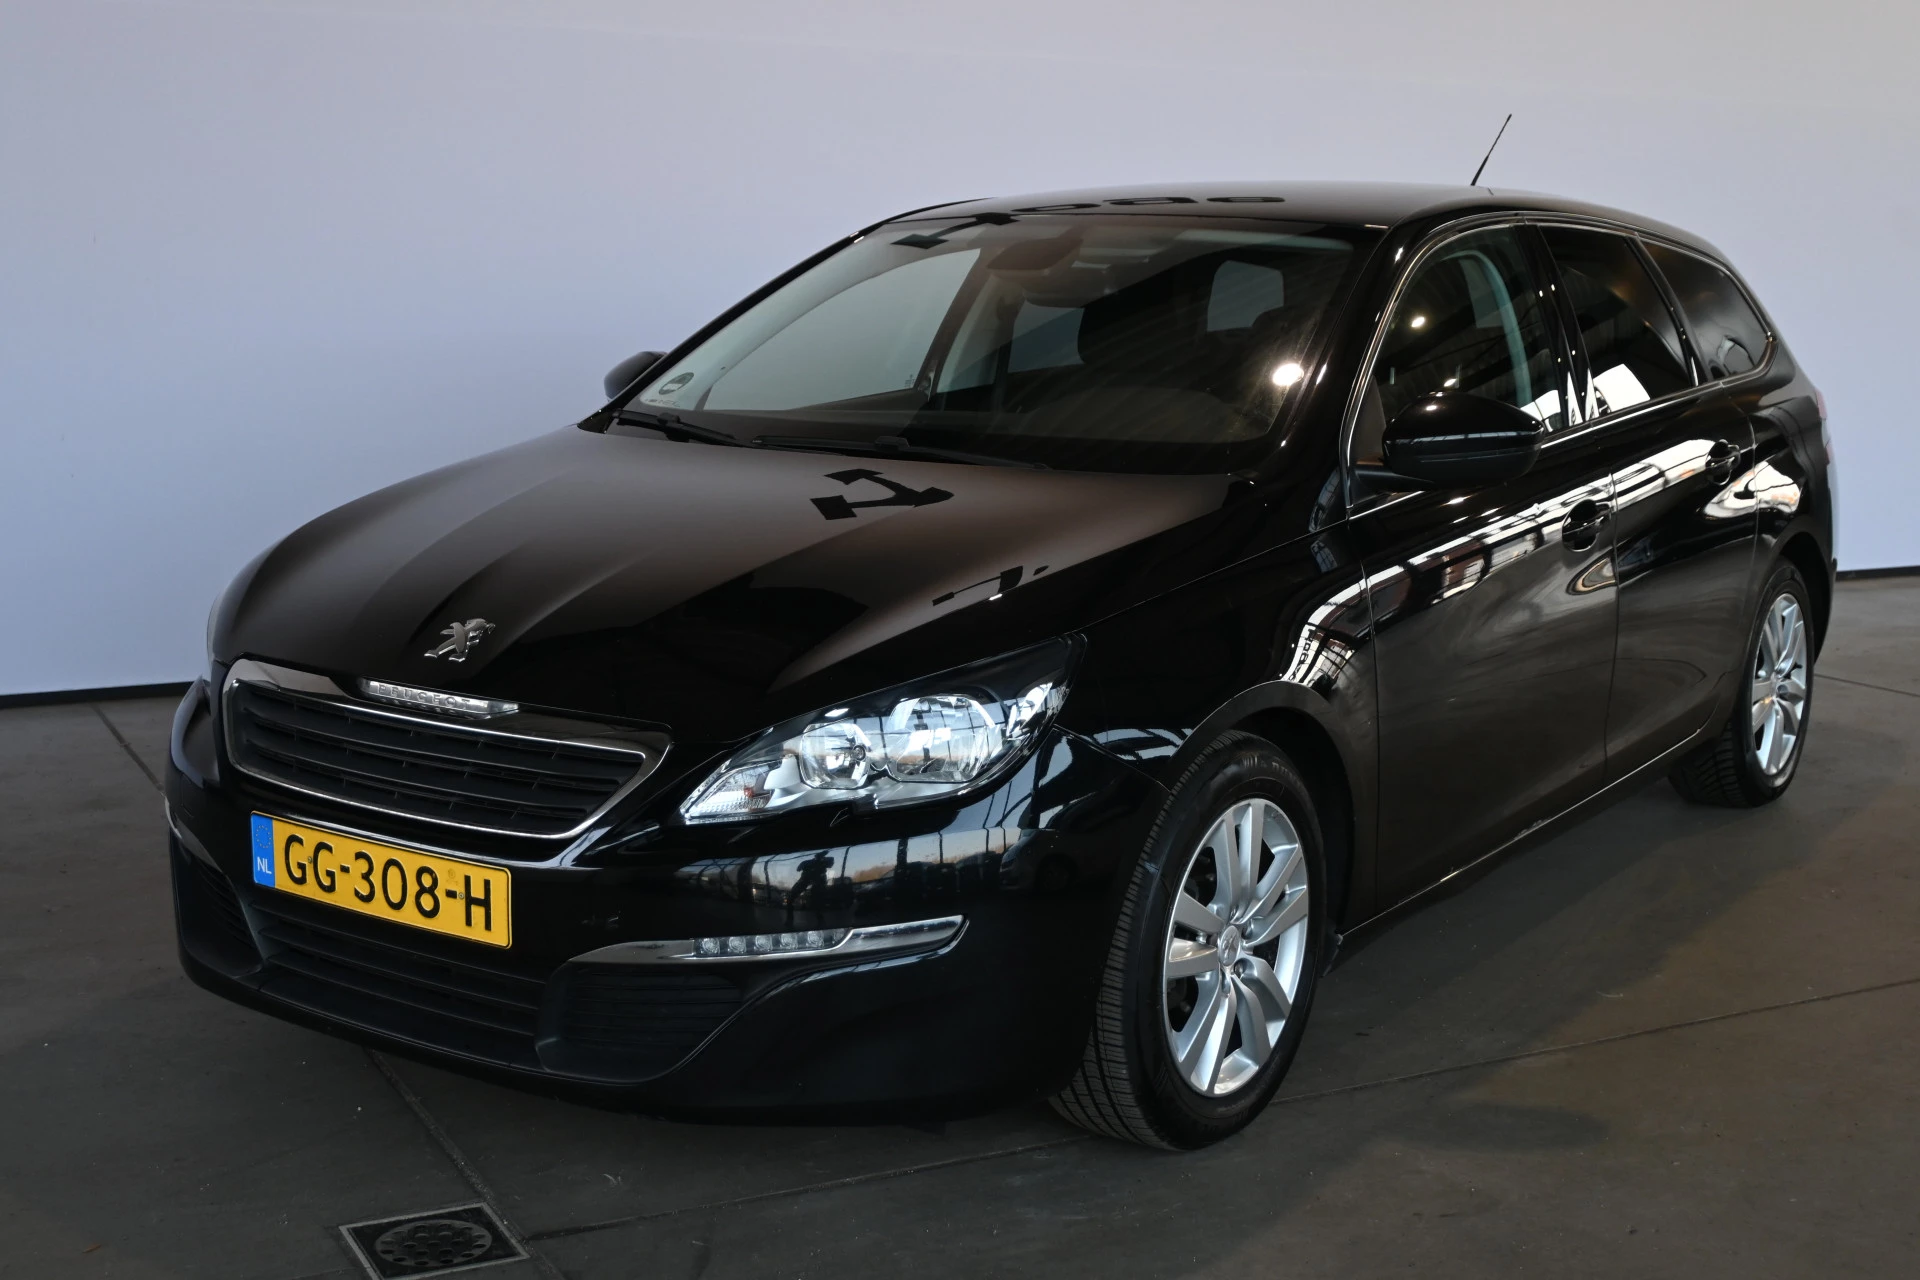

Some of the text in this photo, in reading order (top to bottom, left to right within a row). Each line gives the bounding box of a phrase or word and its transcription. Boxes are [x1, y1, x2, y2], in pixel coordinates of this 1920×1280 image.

[377, 684, 471, 711] PEUGEOT
[257, 856, 272, 875] NL
[284, 833, 492, 931] GG-308-H
